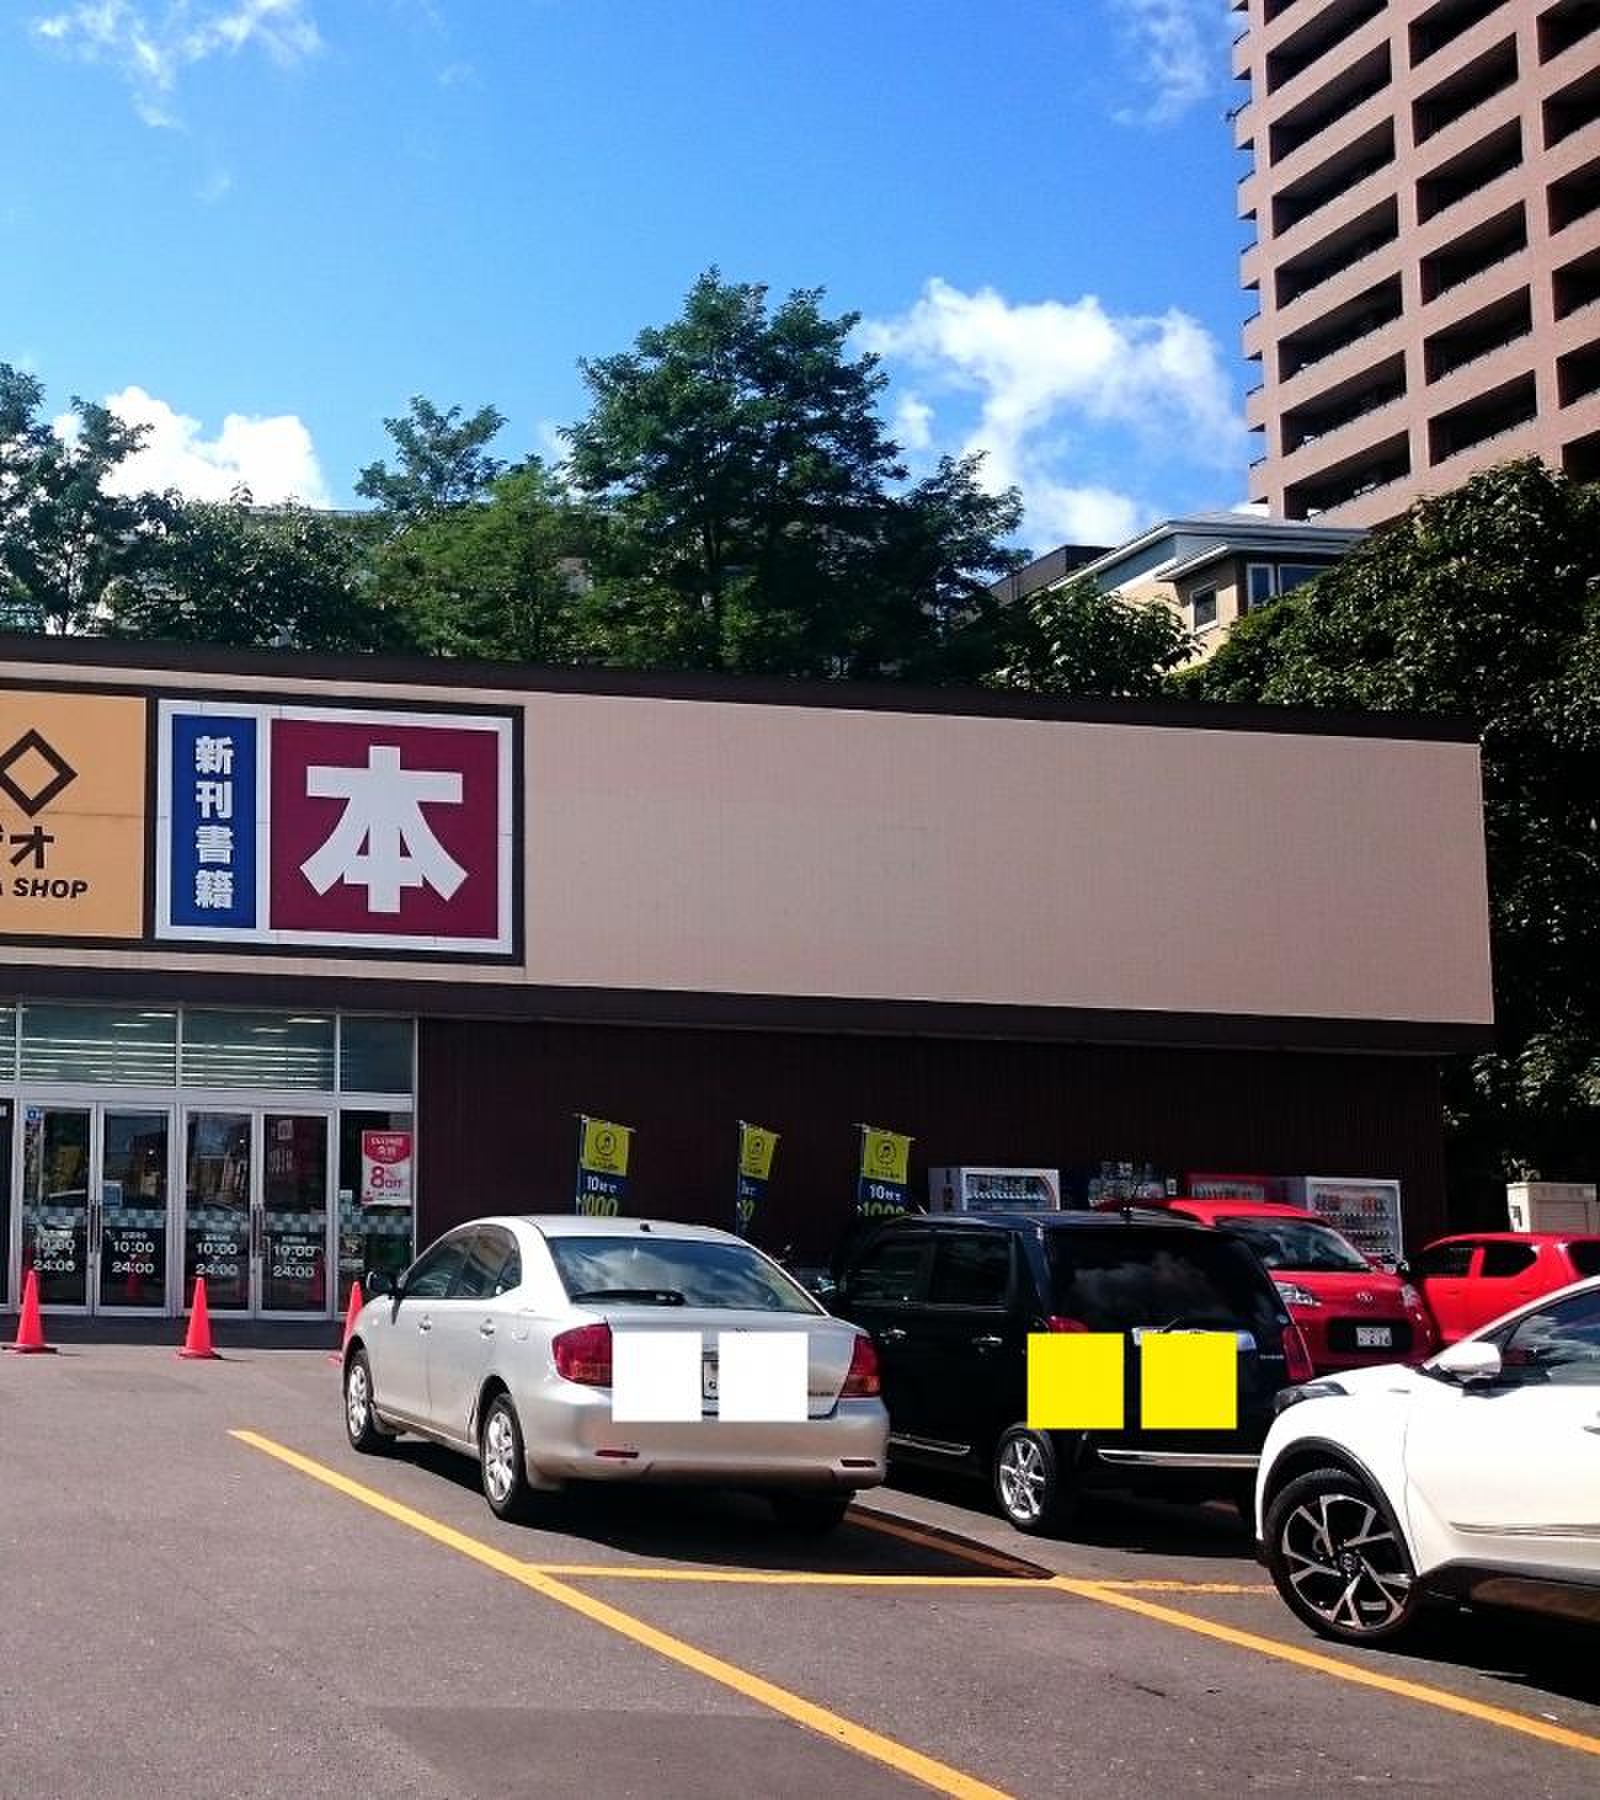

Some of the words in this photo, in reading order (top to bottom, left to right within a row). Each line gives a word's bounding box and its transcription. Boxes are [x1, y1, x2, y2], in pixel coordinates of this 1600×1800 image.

[195, 735, 234, 909] 新刊書籍
[300, 745, 468, 913] 本
[12, 877, 88, 899] SHOP
[113, 1241, 155, 1253] 10:00
[196, 1243, 238, 1255] 10:00
[112, 1261, 155, 1274] 24:00
[195, 1264, 238, 1276] 24:00
